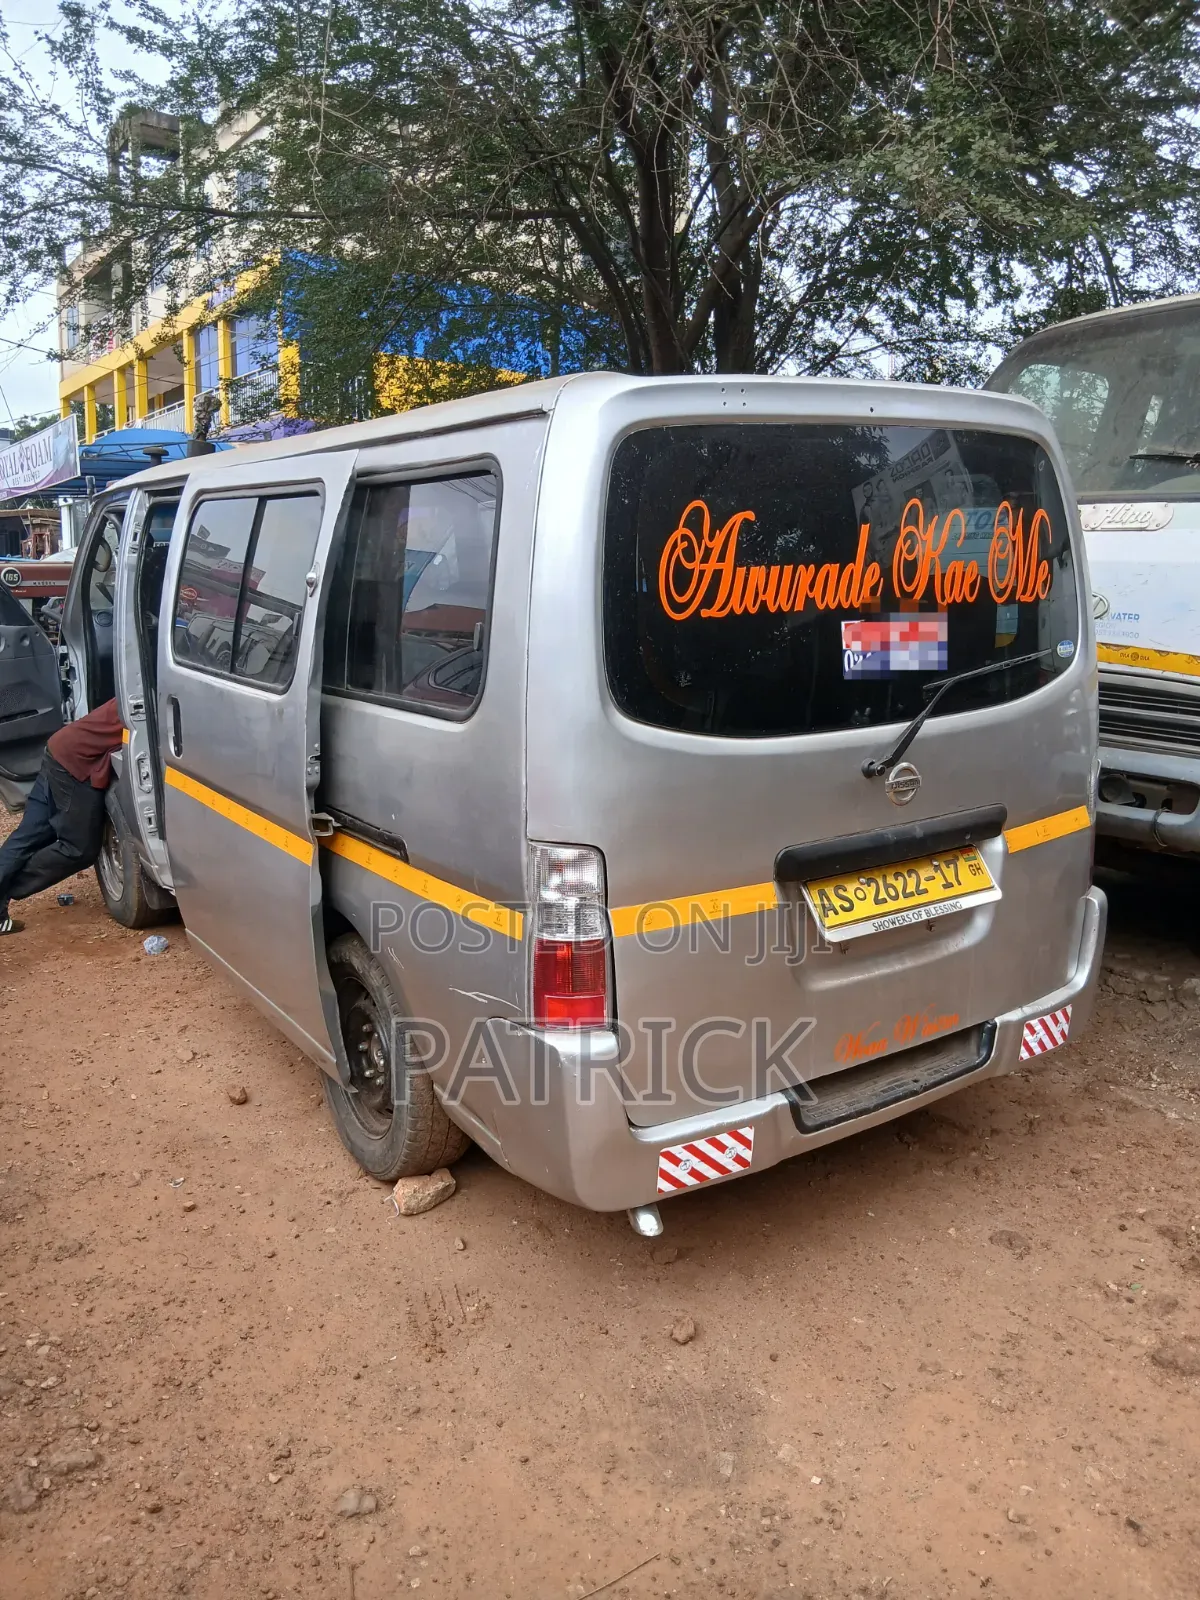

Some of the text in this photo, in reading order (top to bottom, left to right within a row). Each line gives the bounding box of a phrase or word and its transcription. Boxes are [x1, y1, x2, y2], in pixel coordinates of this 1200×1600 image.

[25, 435, 53, 471] FOAM
[658, 498, 1052, 621] Awurade Kae Me
[5, 573, 19, 582] 165
[968, 863, 983, 877] GH
[817, 856, 962, 918] AS 2622-17
[872, 901, 963, 932] SHOWERS OF BLESSING
